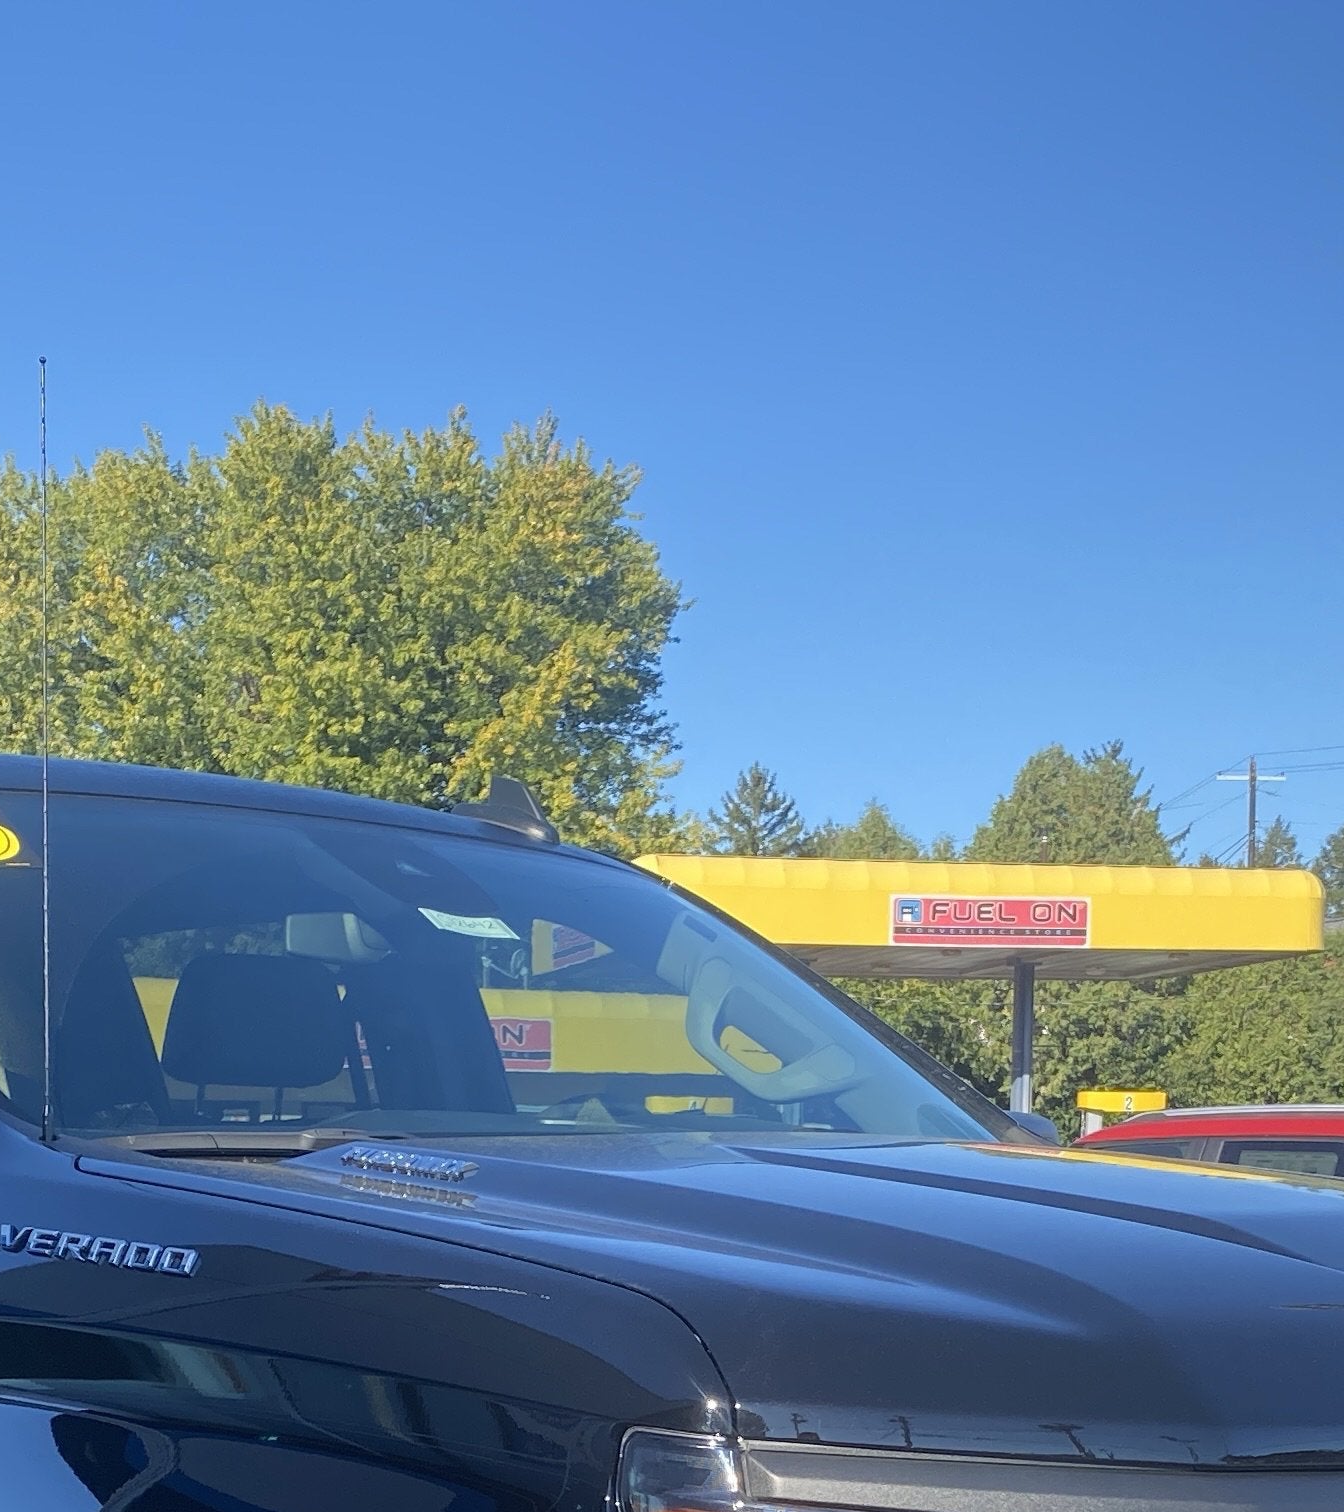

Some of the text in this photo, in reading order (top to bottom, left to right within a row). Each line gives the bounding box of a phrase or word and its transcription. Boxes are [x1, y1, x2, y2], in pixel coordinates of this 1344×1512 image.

[930, 902, 1077, 923] FUEL ON
[905, 927, 1072, 937] CONVENIENCE STORE
[1125, 1096, 1133, 1111] 2
